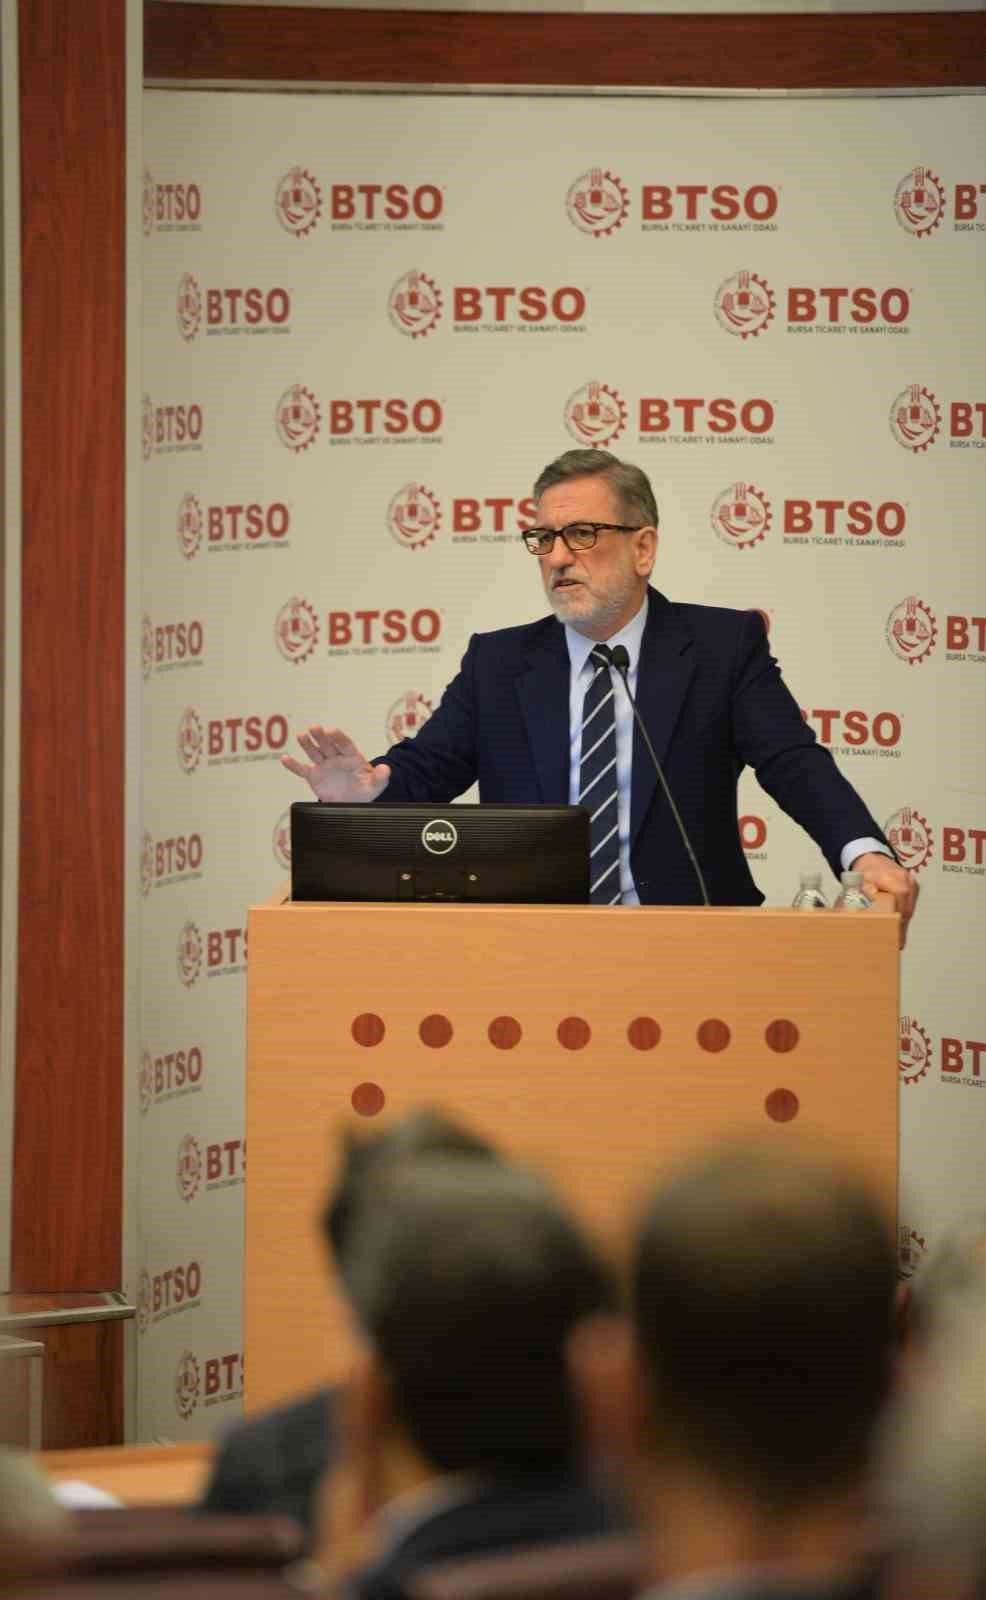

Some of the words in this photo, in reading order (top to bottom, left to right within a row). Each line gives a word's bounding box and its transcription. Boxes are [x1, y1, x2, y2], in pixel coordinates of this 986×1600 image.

[156, 184, 201, 220] BTSO
[331, 184, 443, 220] BTSO
[641, 184, 779, 222] BTSO
[207, 287, 290, 325] BTSO
[454, 286, 587, 322] BTSO
[787, 287, 910, 324] BTSO
[156, 404, 203, 442] BTSO
[329, 398, 443, 435] BTSO
[639, 398, 774, 434] BTSO
[208, 502, 290, 541] BTSO
[783, 499, 906, 538] BTSO
[156, 621, 203, 662] BTSO
[328, 608, 441, 646] BTSO
[208, 714, 289, 755] BTSO
[800, 709, 902, 747] TSO
[155, 834, 203, 877] BTSO
[426, 831, 453, 842] DELL
[207, 928, 248, 967] BT
[154, 1046, 202, 1094] BTSO
[207, 1139, 247, 1181] BT
[153, 1262, 201, 1312] BTSO
[204, 1353, 244, 1396] BT
